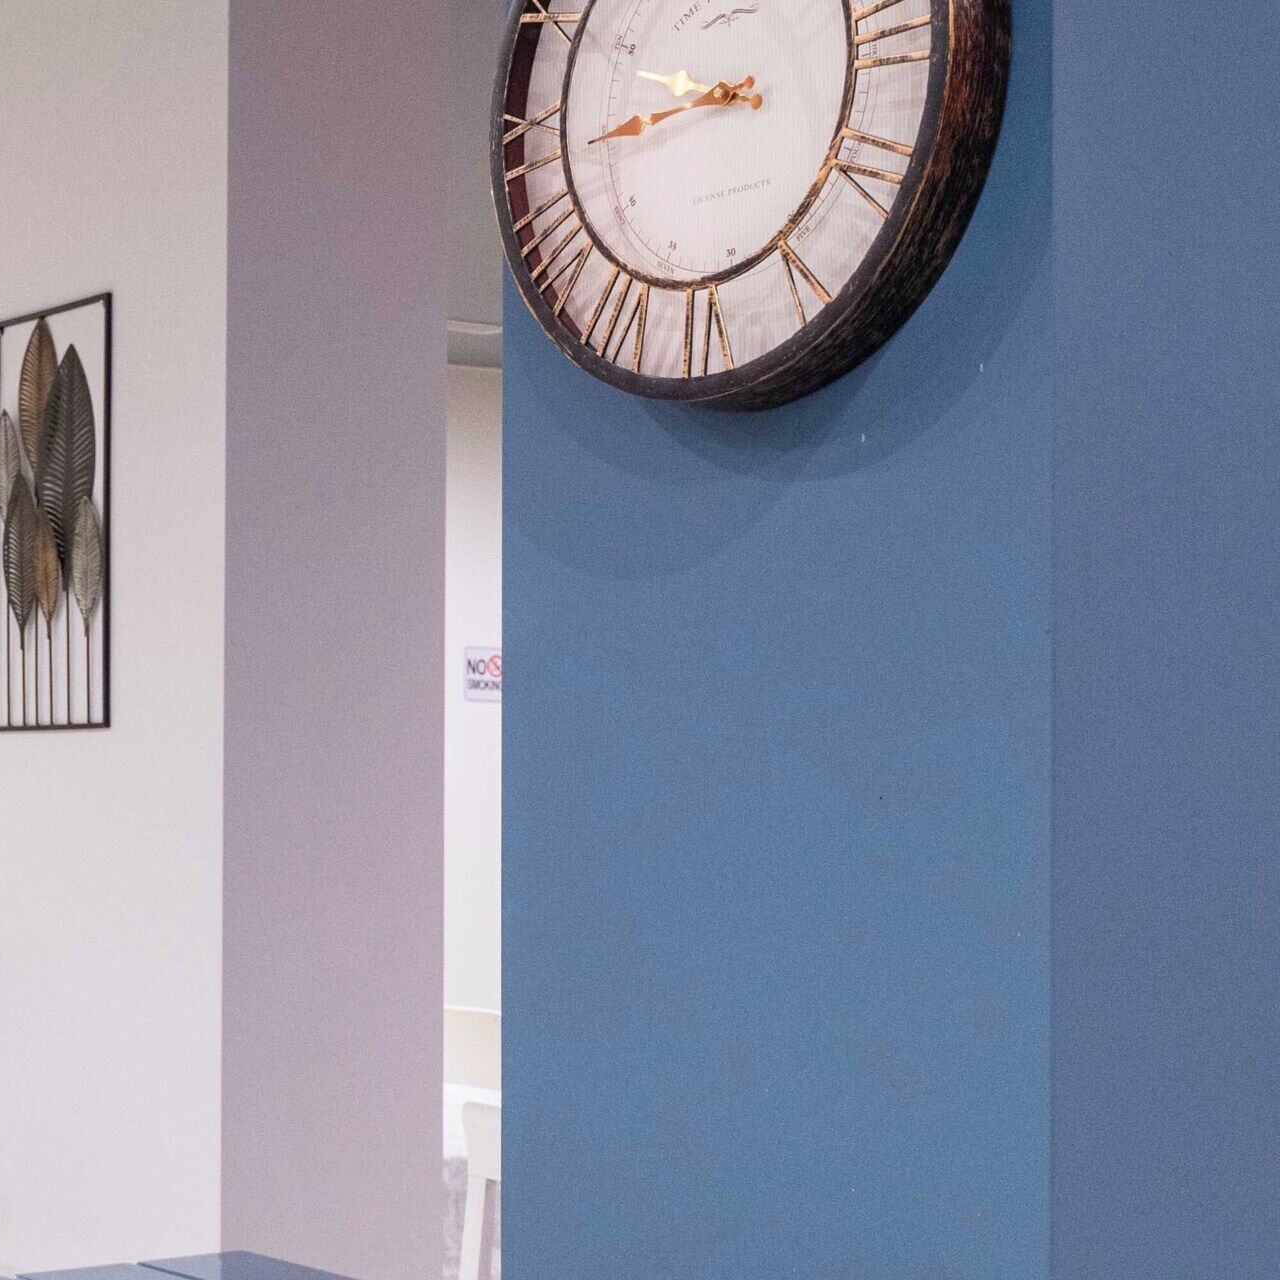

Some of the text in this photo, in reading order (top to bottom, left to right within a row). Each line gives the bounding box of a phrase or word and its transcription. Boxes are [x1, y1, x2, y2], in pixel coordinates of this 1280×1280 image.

[672, 1, 703, 32] TIME
[627, 43, 637, 57] 50
[693, 178, 772, 205] LICENSE PRODUCTS
[628, 195, 637, 207] 40
[614, 205, 626, 226] EIGHT
[796, 226, 811, 243] FIVE
[668, 240, 677, 251] 35
[725, 248, 736, 258] 30
[467, 658, 486, 675] NO
[466, 679, 501, 690] SMOKIN
